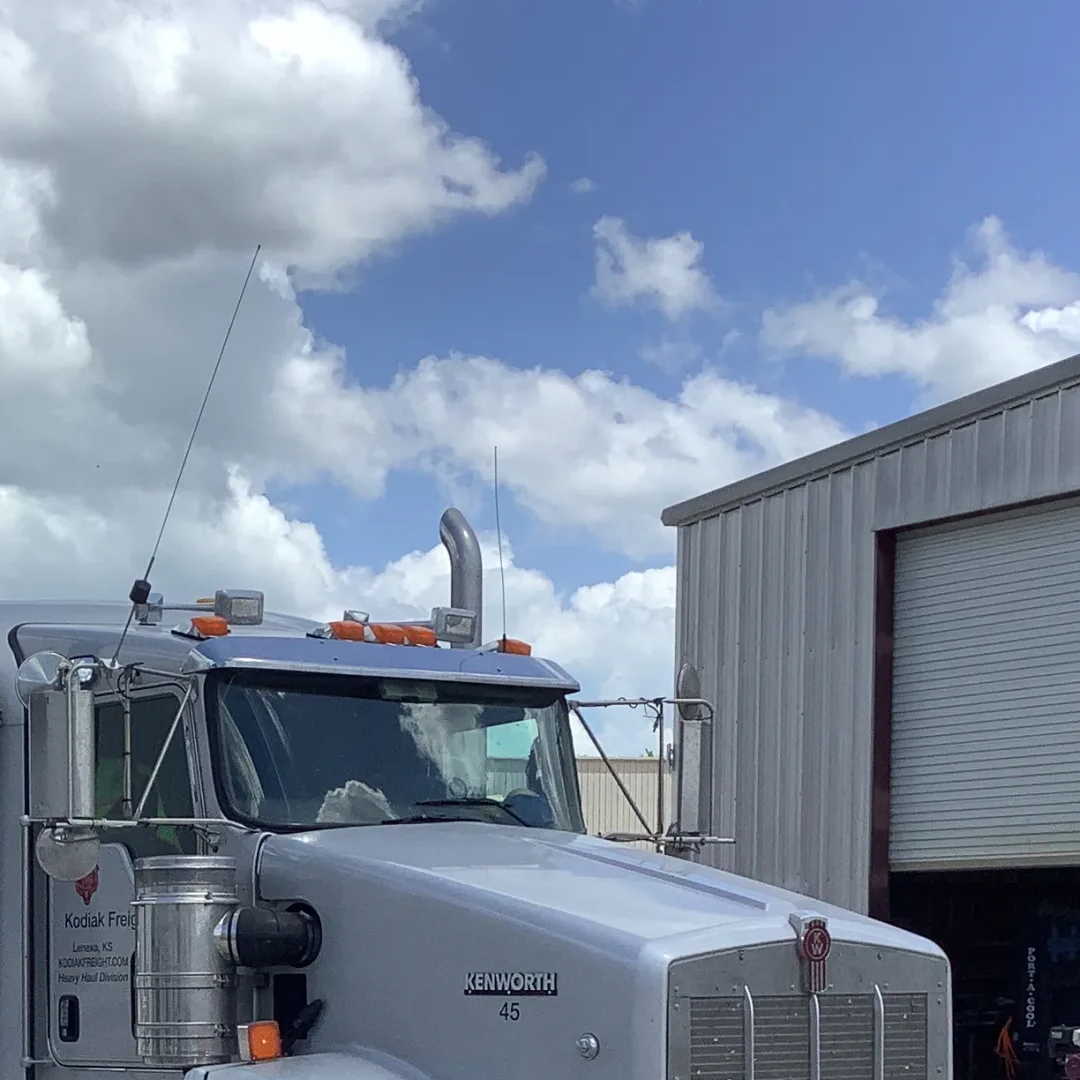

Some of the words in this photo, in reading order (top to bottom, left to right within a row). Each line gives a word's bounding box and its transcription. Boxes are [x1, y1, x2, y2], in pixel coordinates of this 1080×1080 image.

[64, 912, 105, 929] Kodiak
[72, 942, 100, 953] Lenexa,
[102, 941, 114, 952] KS
[58, 973, 80, 985] Heavy
[81, 971, 98, 982] Haul
[99, 972, 129, 982] Division
[464, 972, 557, 992] KENWORTH
[499, 1002, 520, 1021] 45
